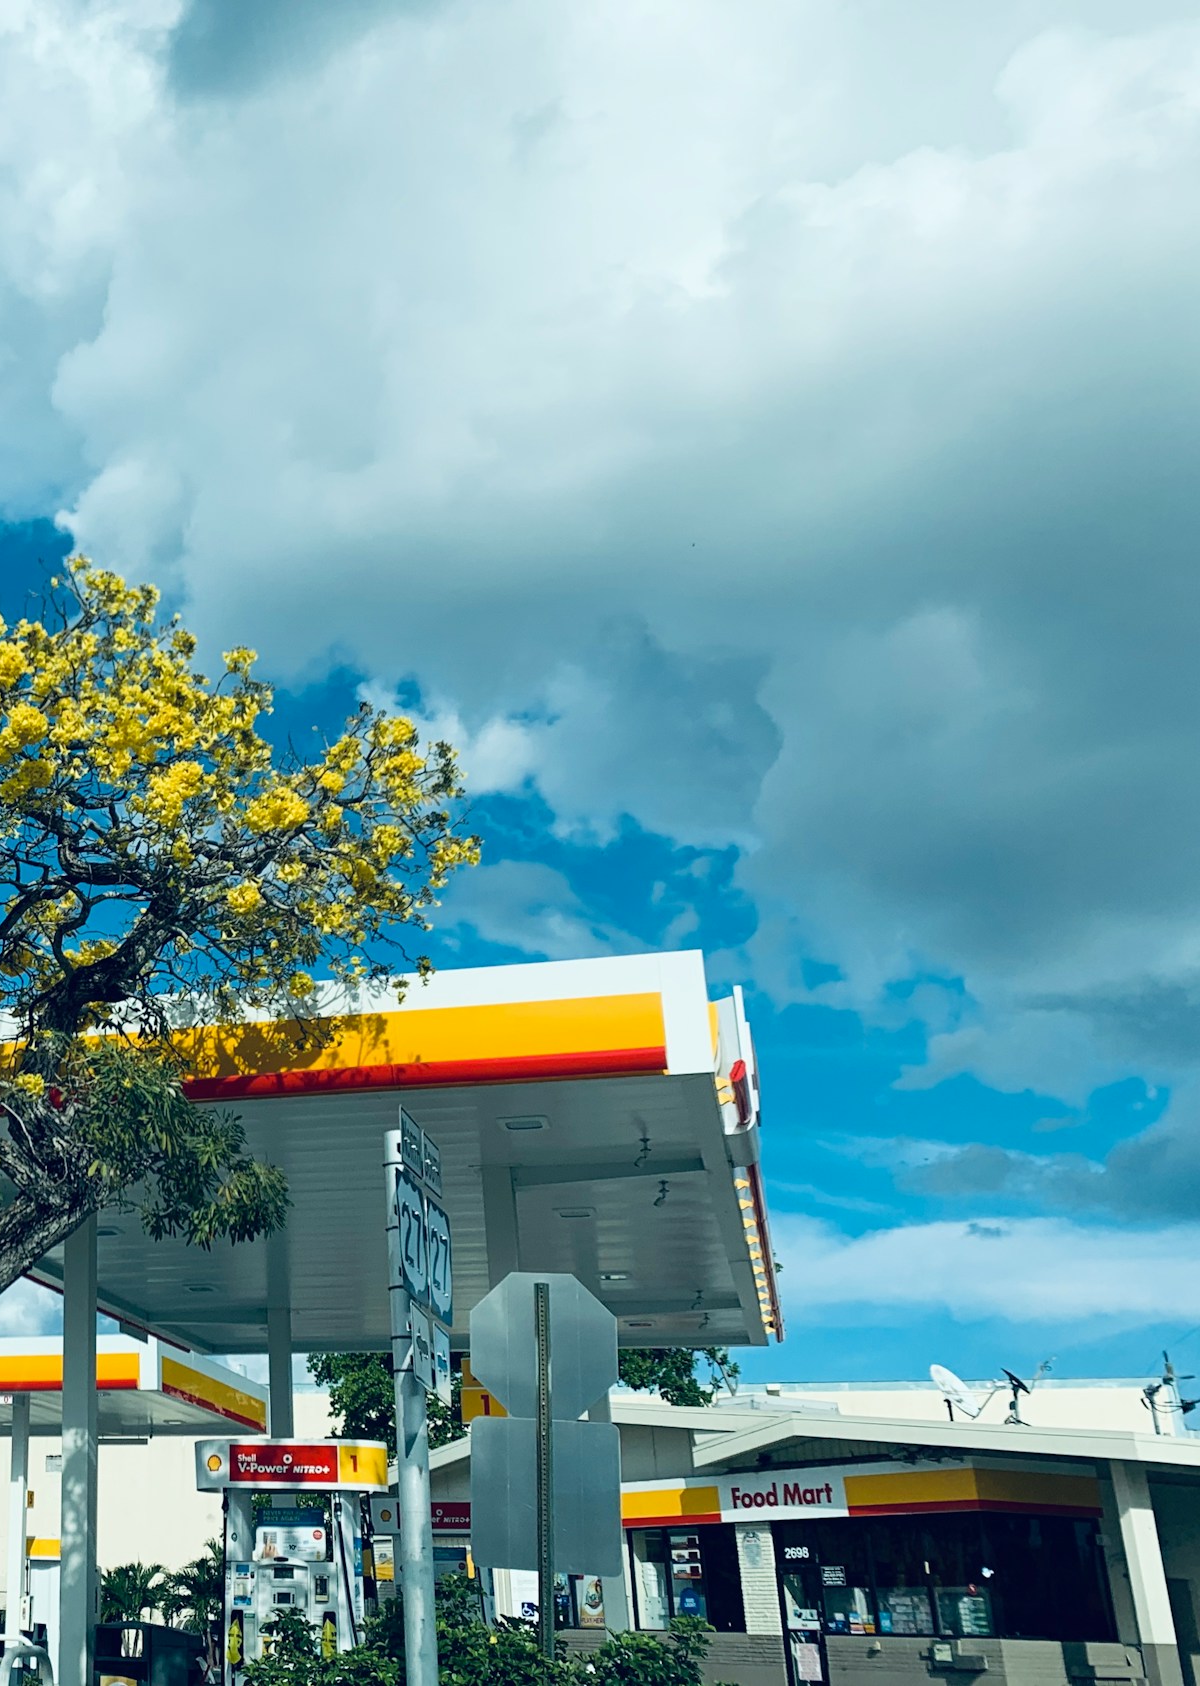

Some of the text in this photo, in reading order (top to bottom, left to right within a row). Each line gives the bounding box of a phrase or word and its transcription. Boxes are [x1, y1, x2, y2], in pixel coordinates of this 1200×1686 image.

[402, 1201, 423, 1276] 27
[431, 1227, 449, 1298] 27
[238, 1454, 256, 1462] Shell
[350, 1455, 357, 1472] 1
[238, 1463, 330, 1474] V-Power NITRO+
[731, 1482, 833, 1509] Food Mart
[784, 1546, 809, 1559] 2698
